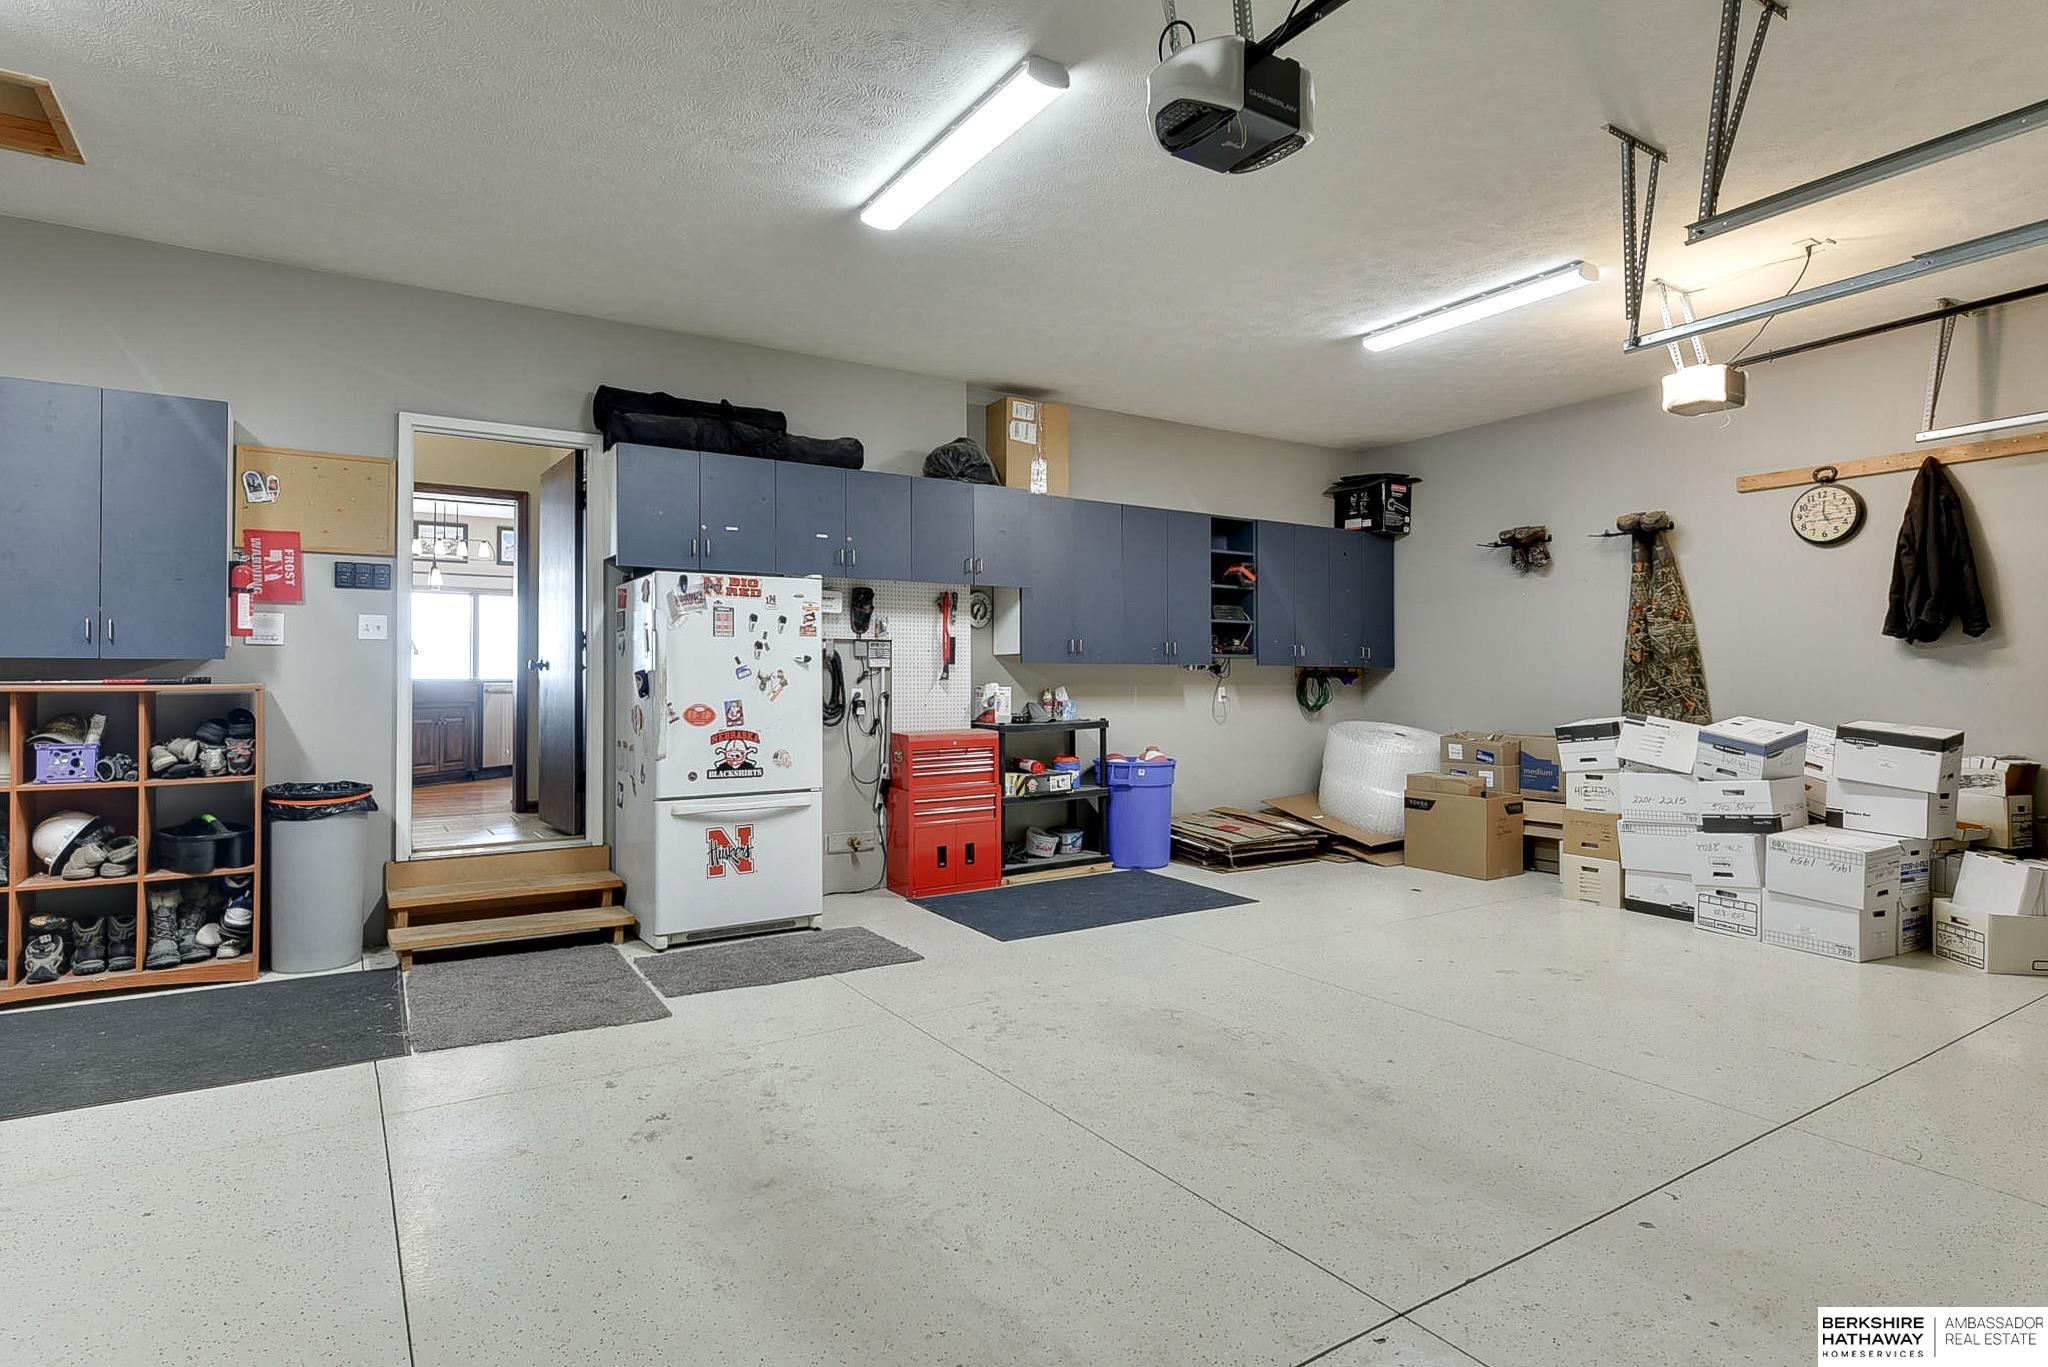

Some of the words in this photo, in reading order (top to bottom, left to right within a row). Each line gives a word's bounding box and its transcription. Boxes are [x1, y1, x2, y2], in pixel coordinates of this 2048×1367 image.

[1807, 495, 1815, 503] 11
[1817, 491, 1827, 499] 12
[1799, 504, 1808, 512] 10
[1846, 507, 1852, 515] 3
[1801, 523, 1807, 531] 8
[1833, 526, 1839, 534] 5
[1810, 528, 1816, 536] 7
[251, 537, 263, 595] WARNING
[284, 548, 295, 586] FROST
[729, 577, 759, 587] BIG
[726, 587, 762, 598] RED
[711, 730, 760, 744] NEBRASKA
[708, 769, 763, 778] BLACKSHIRTS
[1523, 768, 1553, 776] medium
[706, 824, 755, 879] N
[707, 839, 754, 866] Huskers
